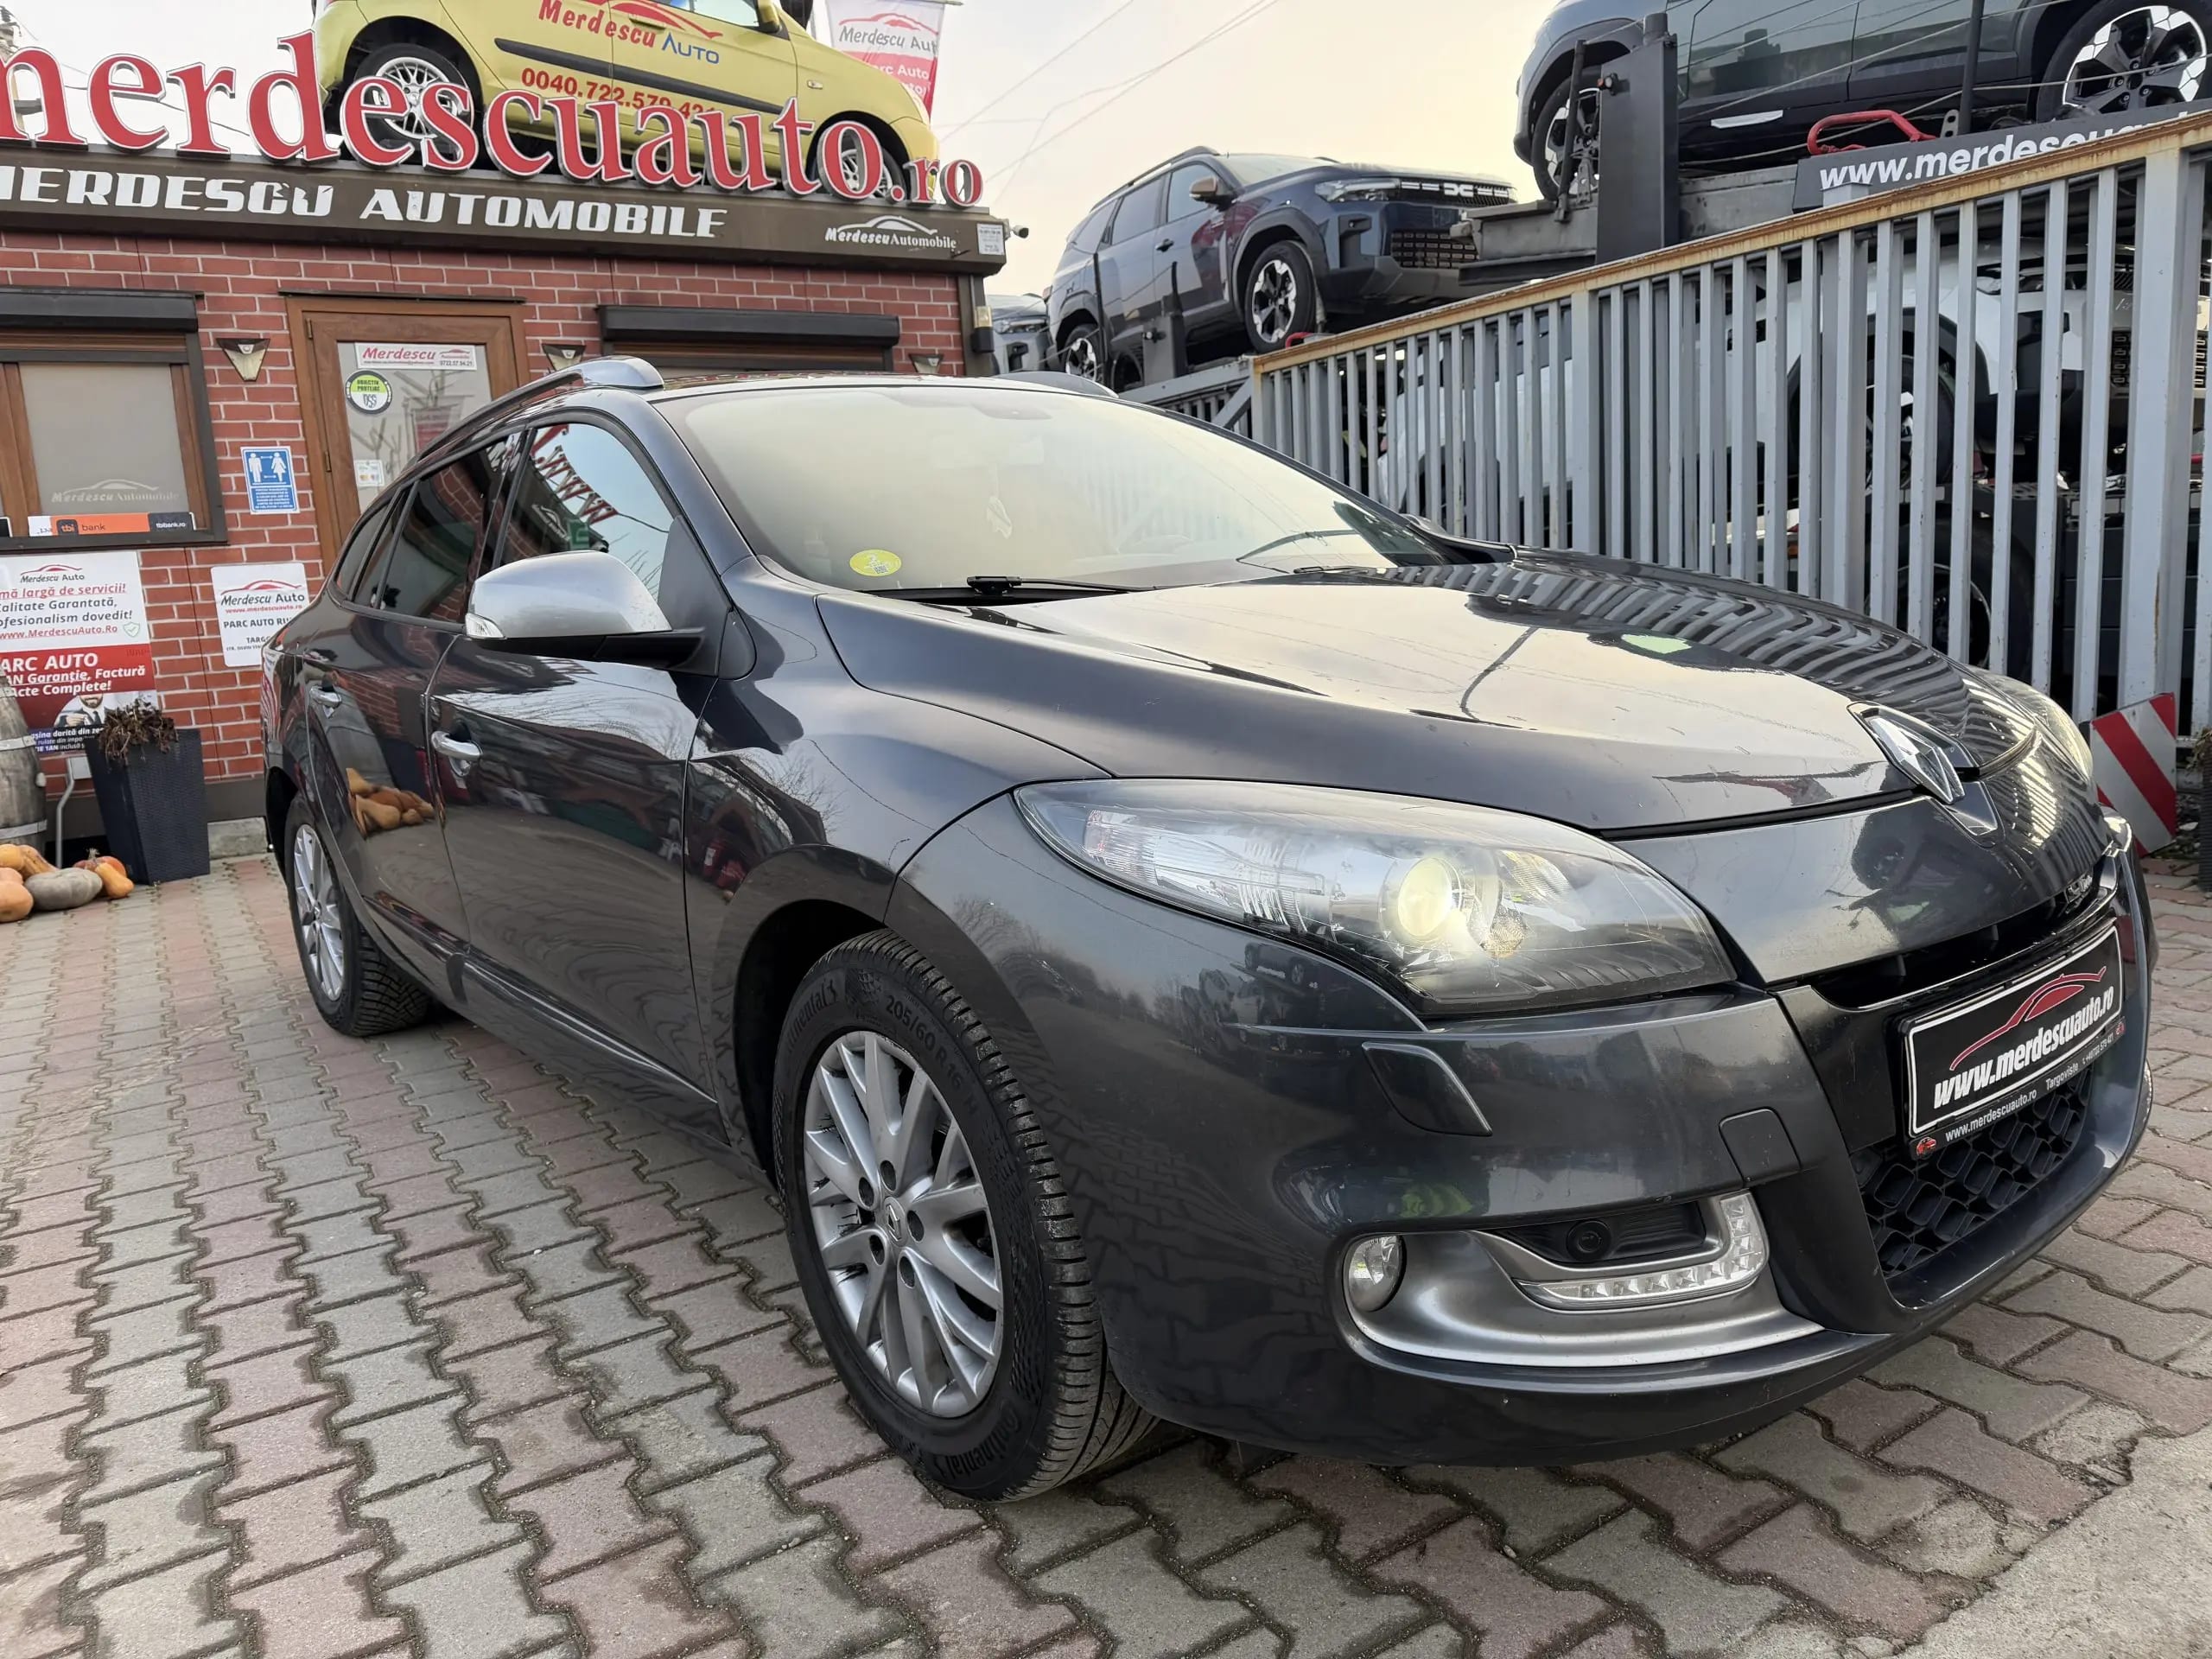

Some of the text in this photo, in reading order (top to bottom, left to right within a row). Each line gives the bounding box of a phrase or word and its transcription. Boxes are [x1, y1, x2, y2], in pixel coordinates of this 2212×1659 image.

[538, 0, 657, 48] Merdescu
[839, 26, 906, 48] Merdescu
[897, 65, 930, 79] Auto
[0, 165, 728, 238] ERDESCU AUTOMOBILE
[362, 346, 435, 360] Merdescu
[51, 492, 114, 503] Merdescu
[20, 575, 59, 583] Merdescu
[22, 586, 55, 599] largă
[60, 586, 74, 595] de
[79, 583, 126, 594] servicii!
[48, 597, 118, 610] Garantată,
[221, 594, 305, 606] Merdescu Auto
[82, 610, 132, 622] dovedit!
[223, 619, 248, 628] PARC
[250, 618, 275, 626] AUTO
[0, 625, 118, 639] www.MerdescuAuto.Ro
[44, 652, 99, 671] AUTO
[96, 664, 146, 679] Factură
[43, 680, 111, 696] Complete!
[886, 995, 937, 1052] 205/60
[1933, 984, 2115, 1109] www.merdescuauto.ro
[1944, 1089, 2037, 1142] www.merdescuauto.ro
